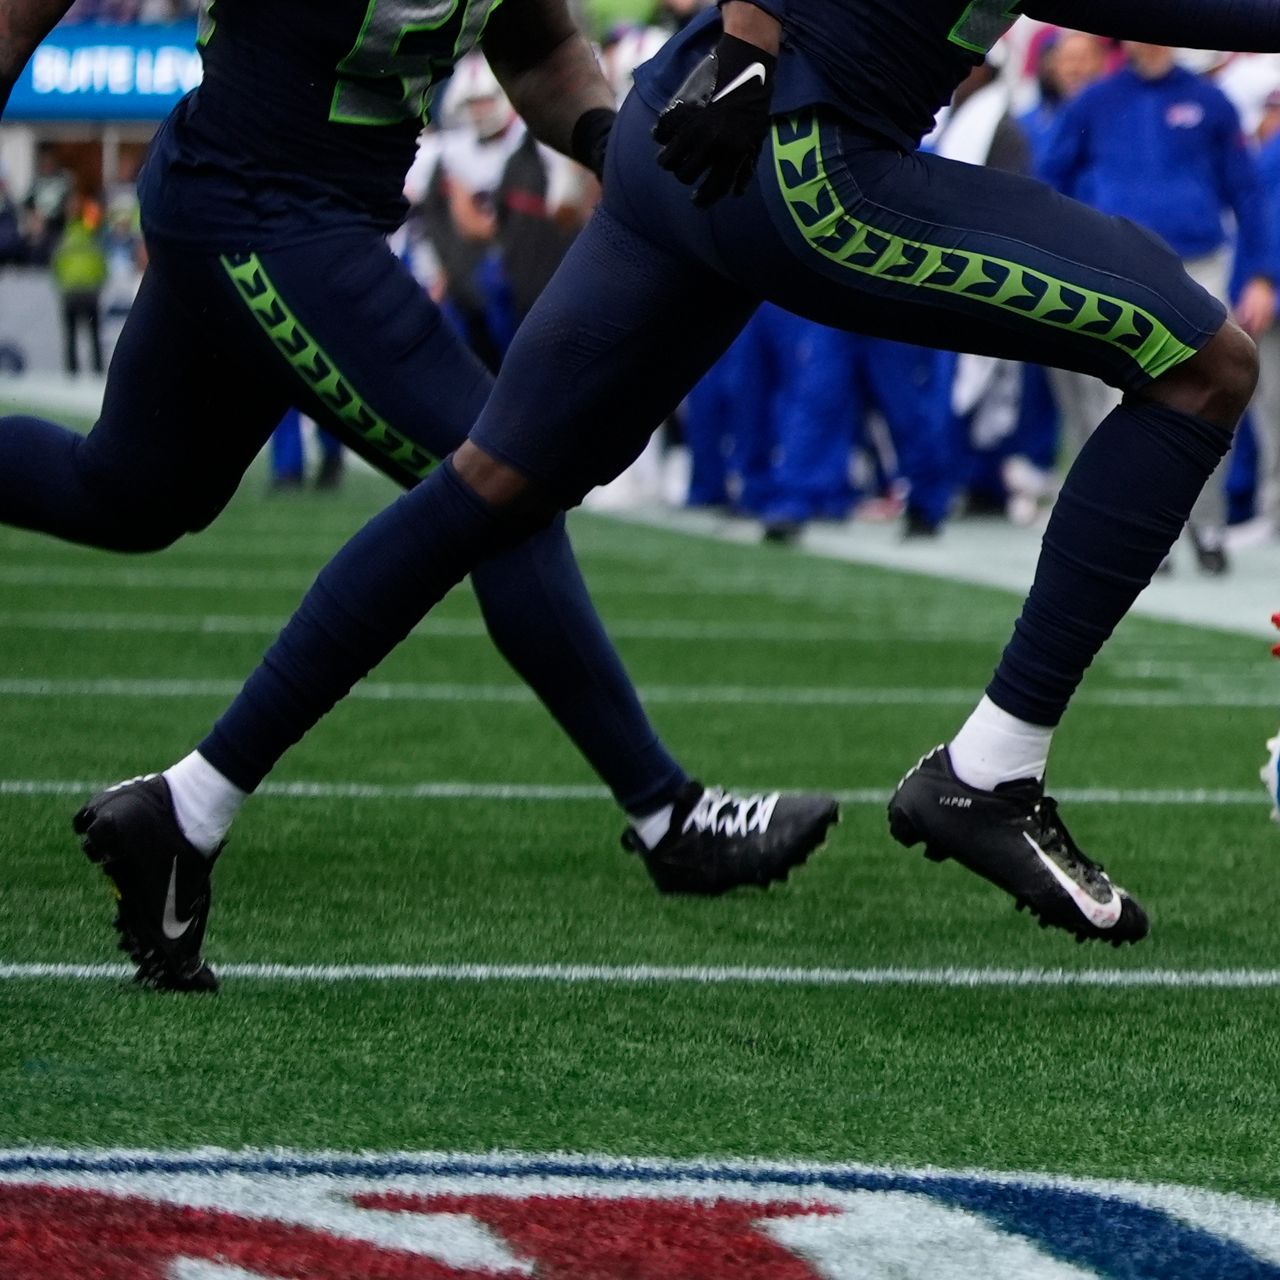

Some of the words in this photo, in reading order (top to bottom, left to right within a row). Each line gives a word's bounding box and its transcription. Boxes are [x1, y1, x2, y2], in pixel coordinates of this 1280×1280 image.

[32, 45, 134, 94] SUITE
[136, 45, 204, 94] LEV
[939, 796, 972, 808] VAPOR
